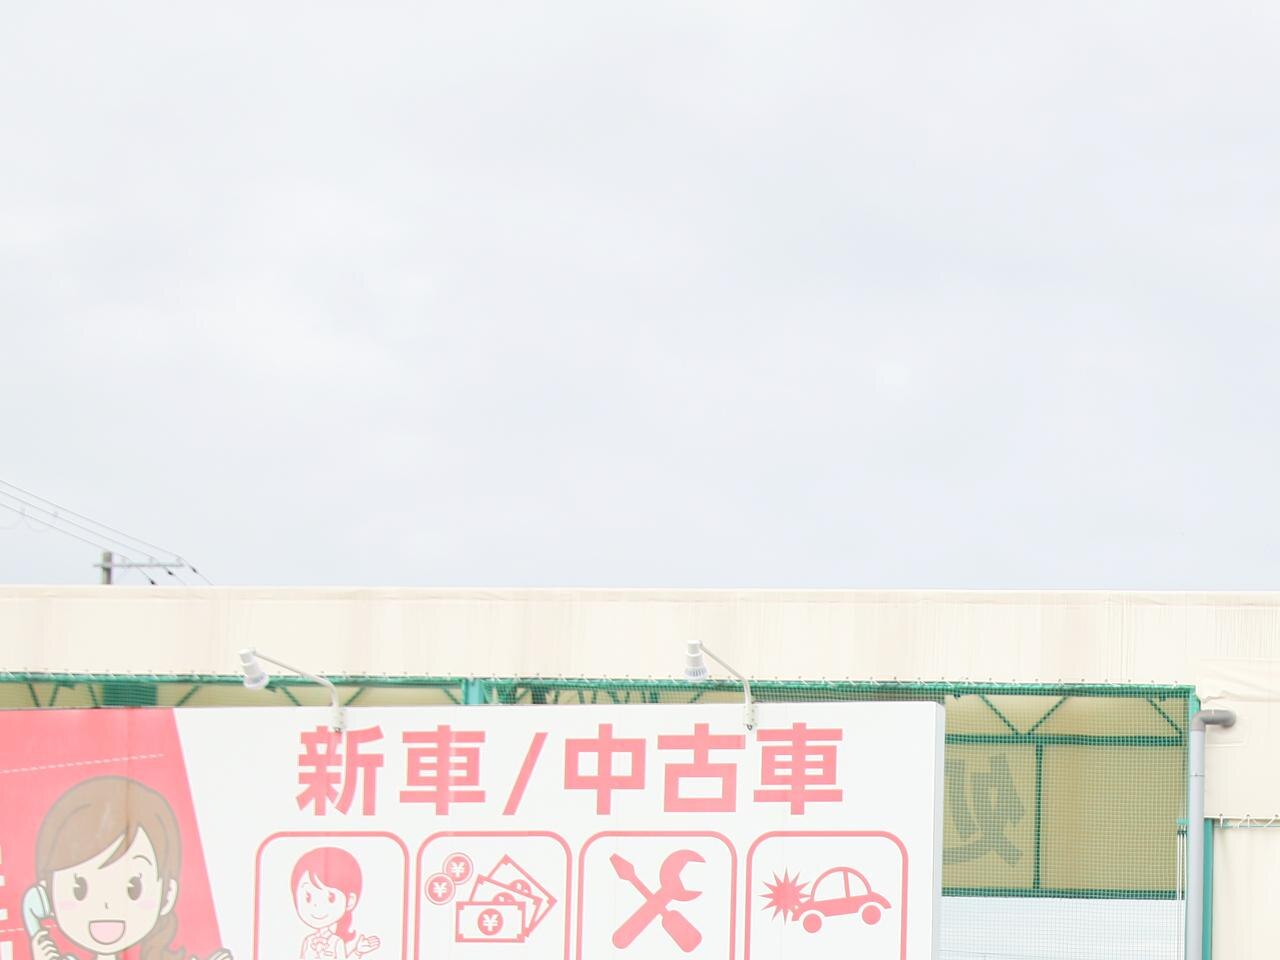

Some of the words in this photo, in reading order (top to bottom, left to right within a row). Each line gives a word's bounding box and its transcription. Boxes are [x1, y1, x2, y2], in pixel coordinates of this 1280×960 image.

[296, 723, 844, 817] 新車/中古車
